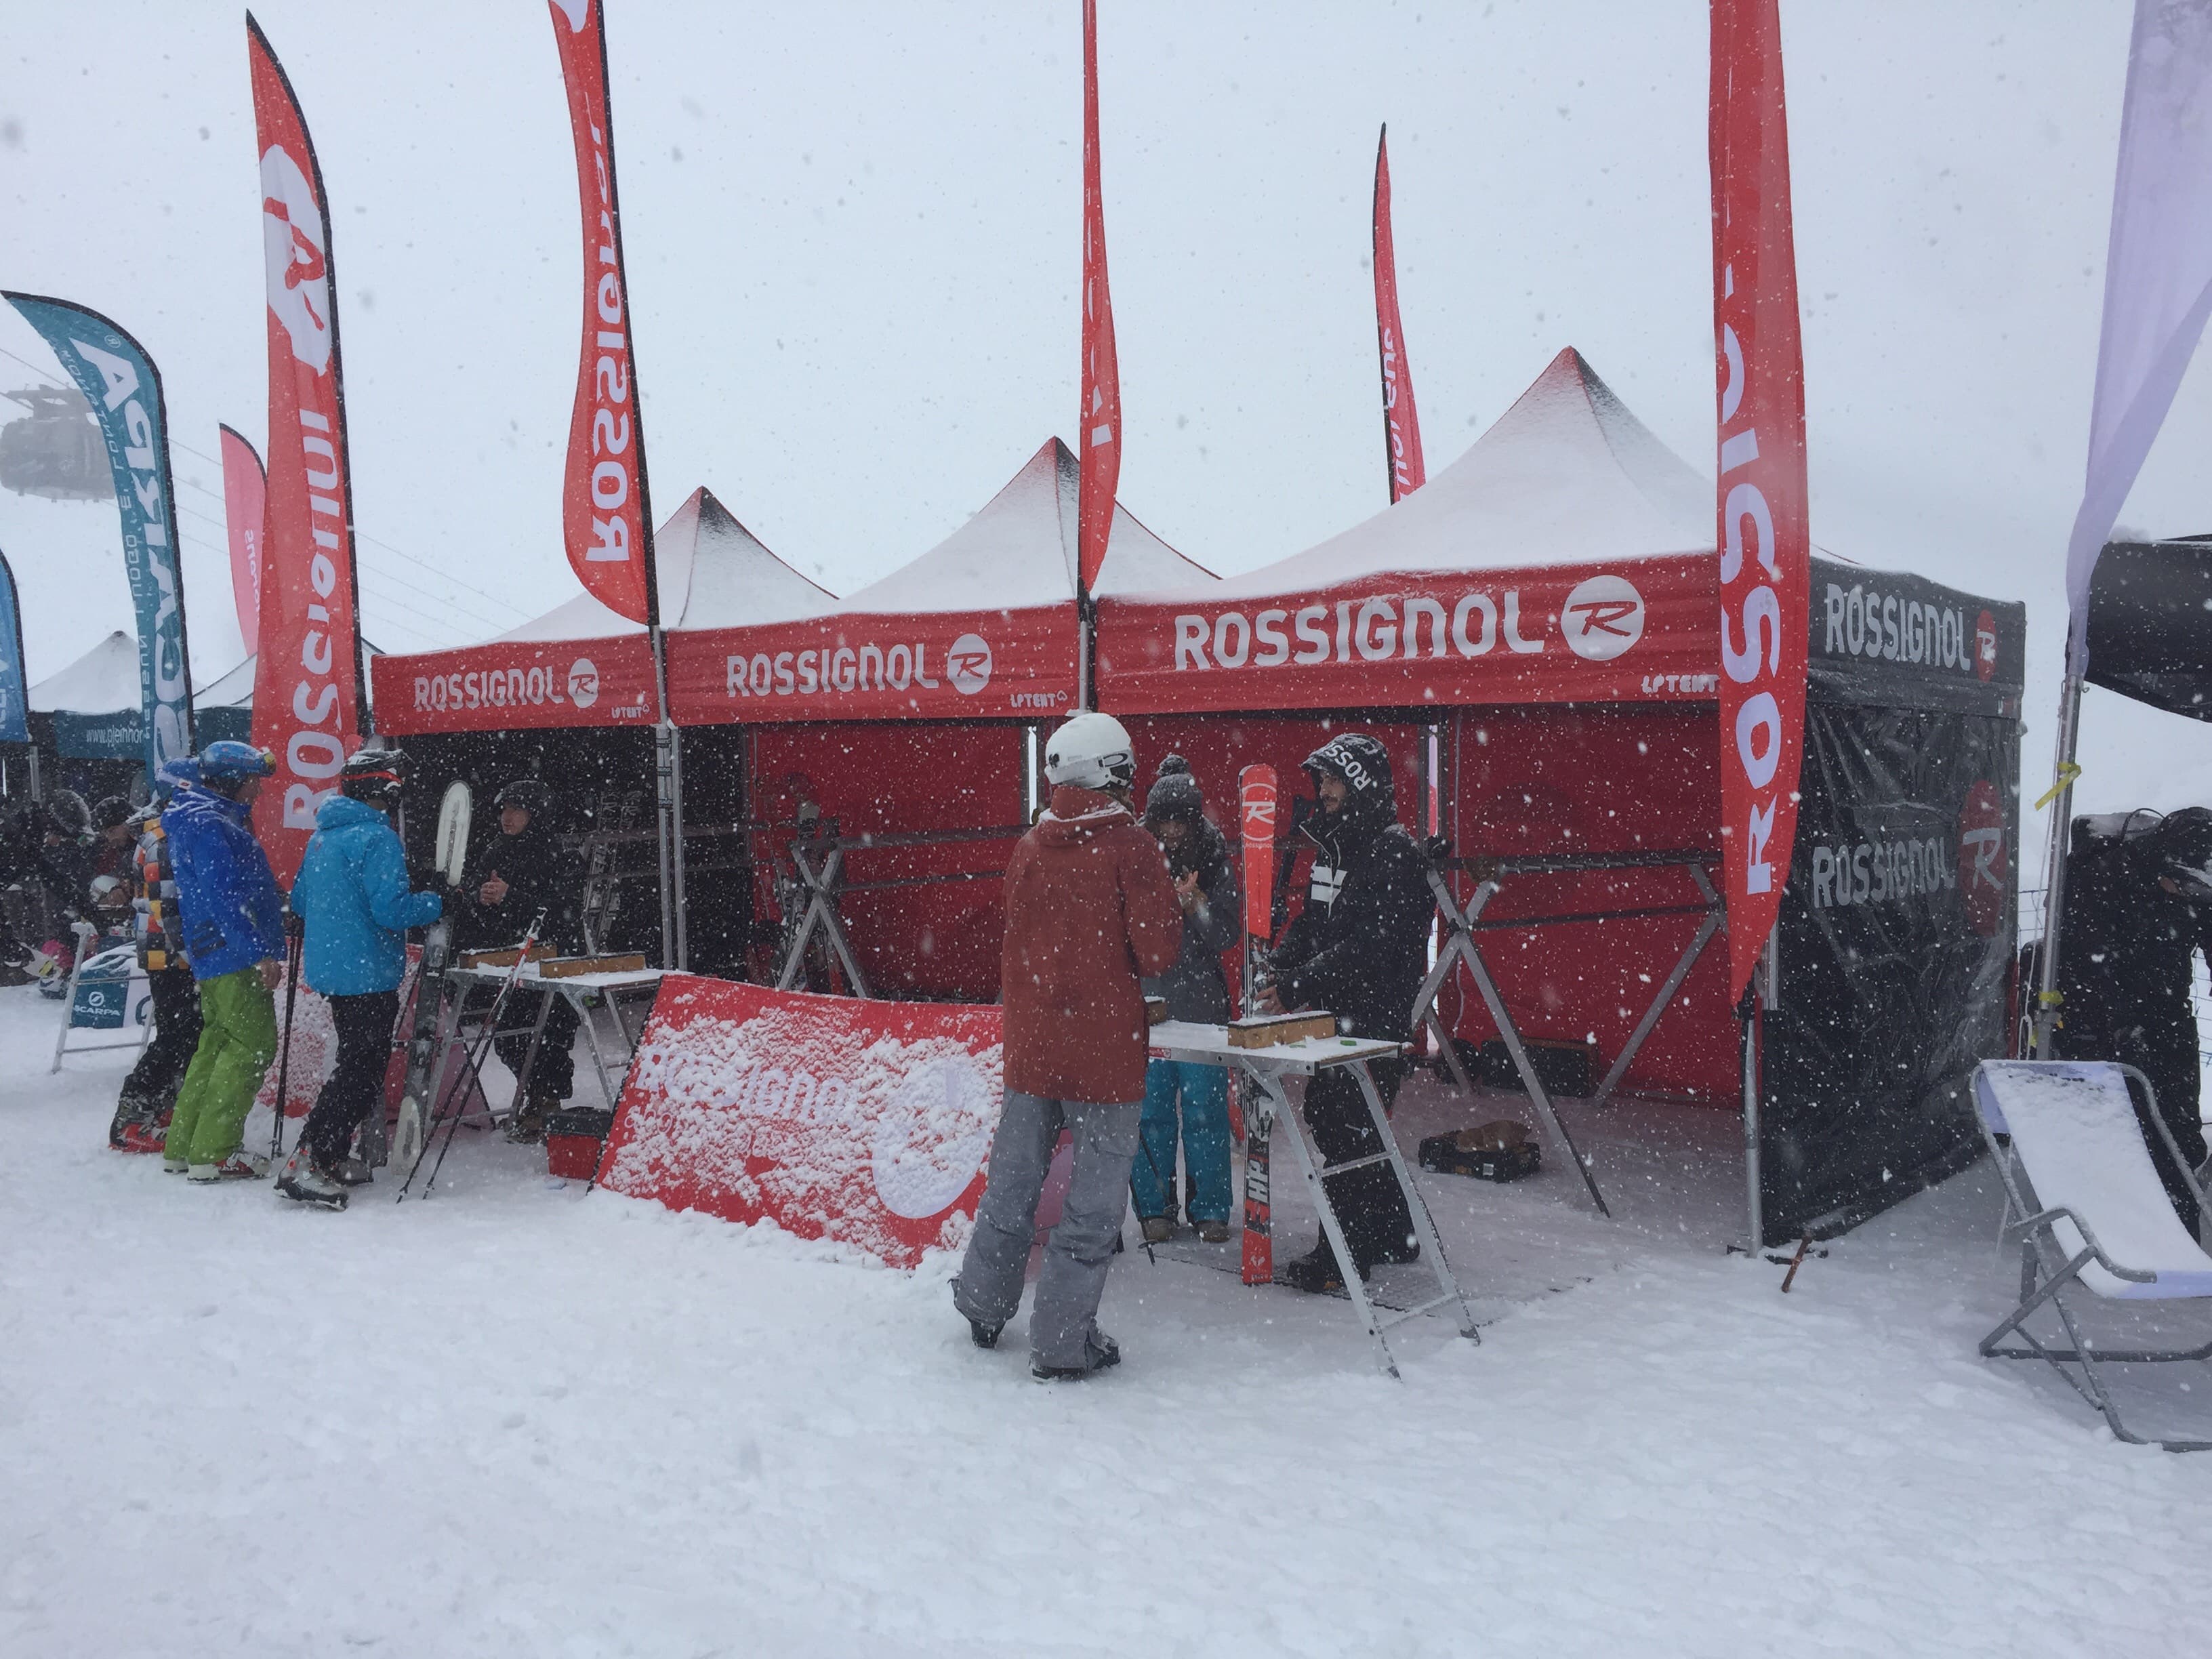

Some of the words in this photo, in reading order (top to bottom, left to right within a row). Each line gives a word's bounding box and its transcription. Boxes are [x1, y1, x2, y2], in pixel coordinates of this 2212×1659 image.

[1174, 592, 1545, 671] ROSSIGNOL
[1826, 583, 1971, 672] ROSSIGNOL
[413, 665, 565, 712] ROSSIGNOL
[726, 643, 939, 698] ROSSIGNOL
[1812, 836, 1956, 908] ROSSIGNOL
